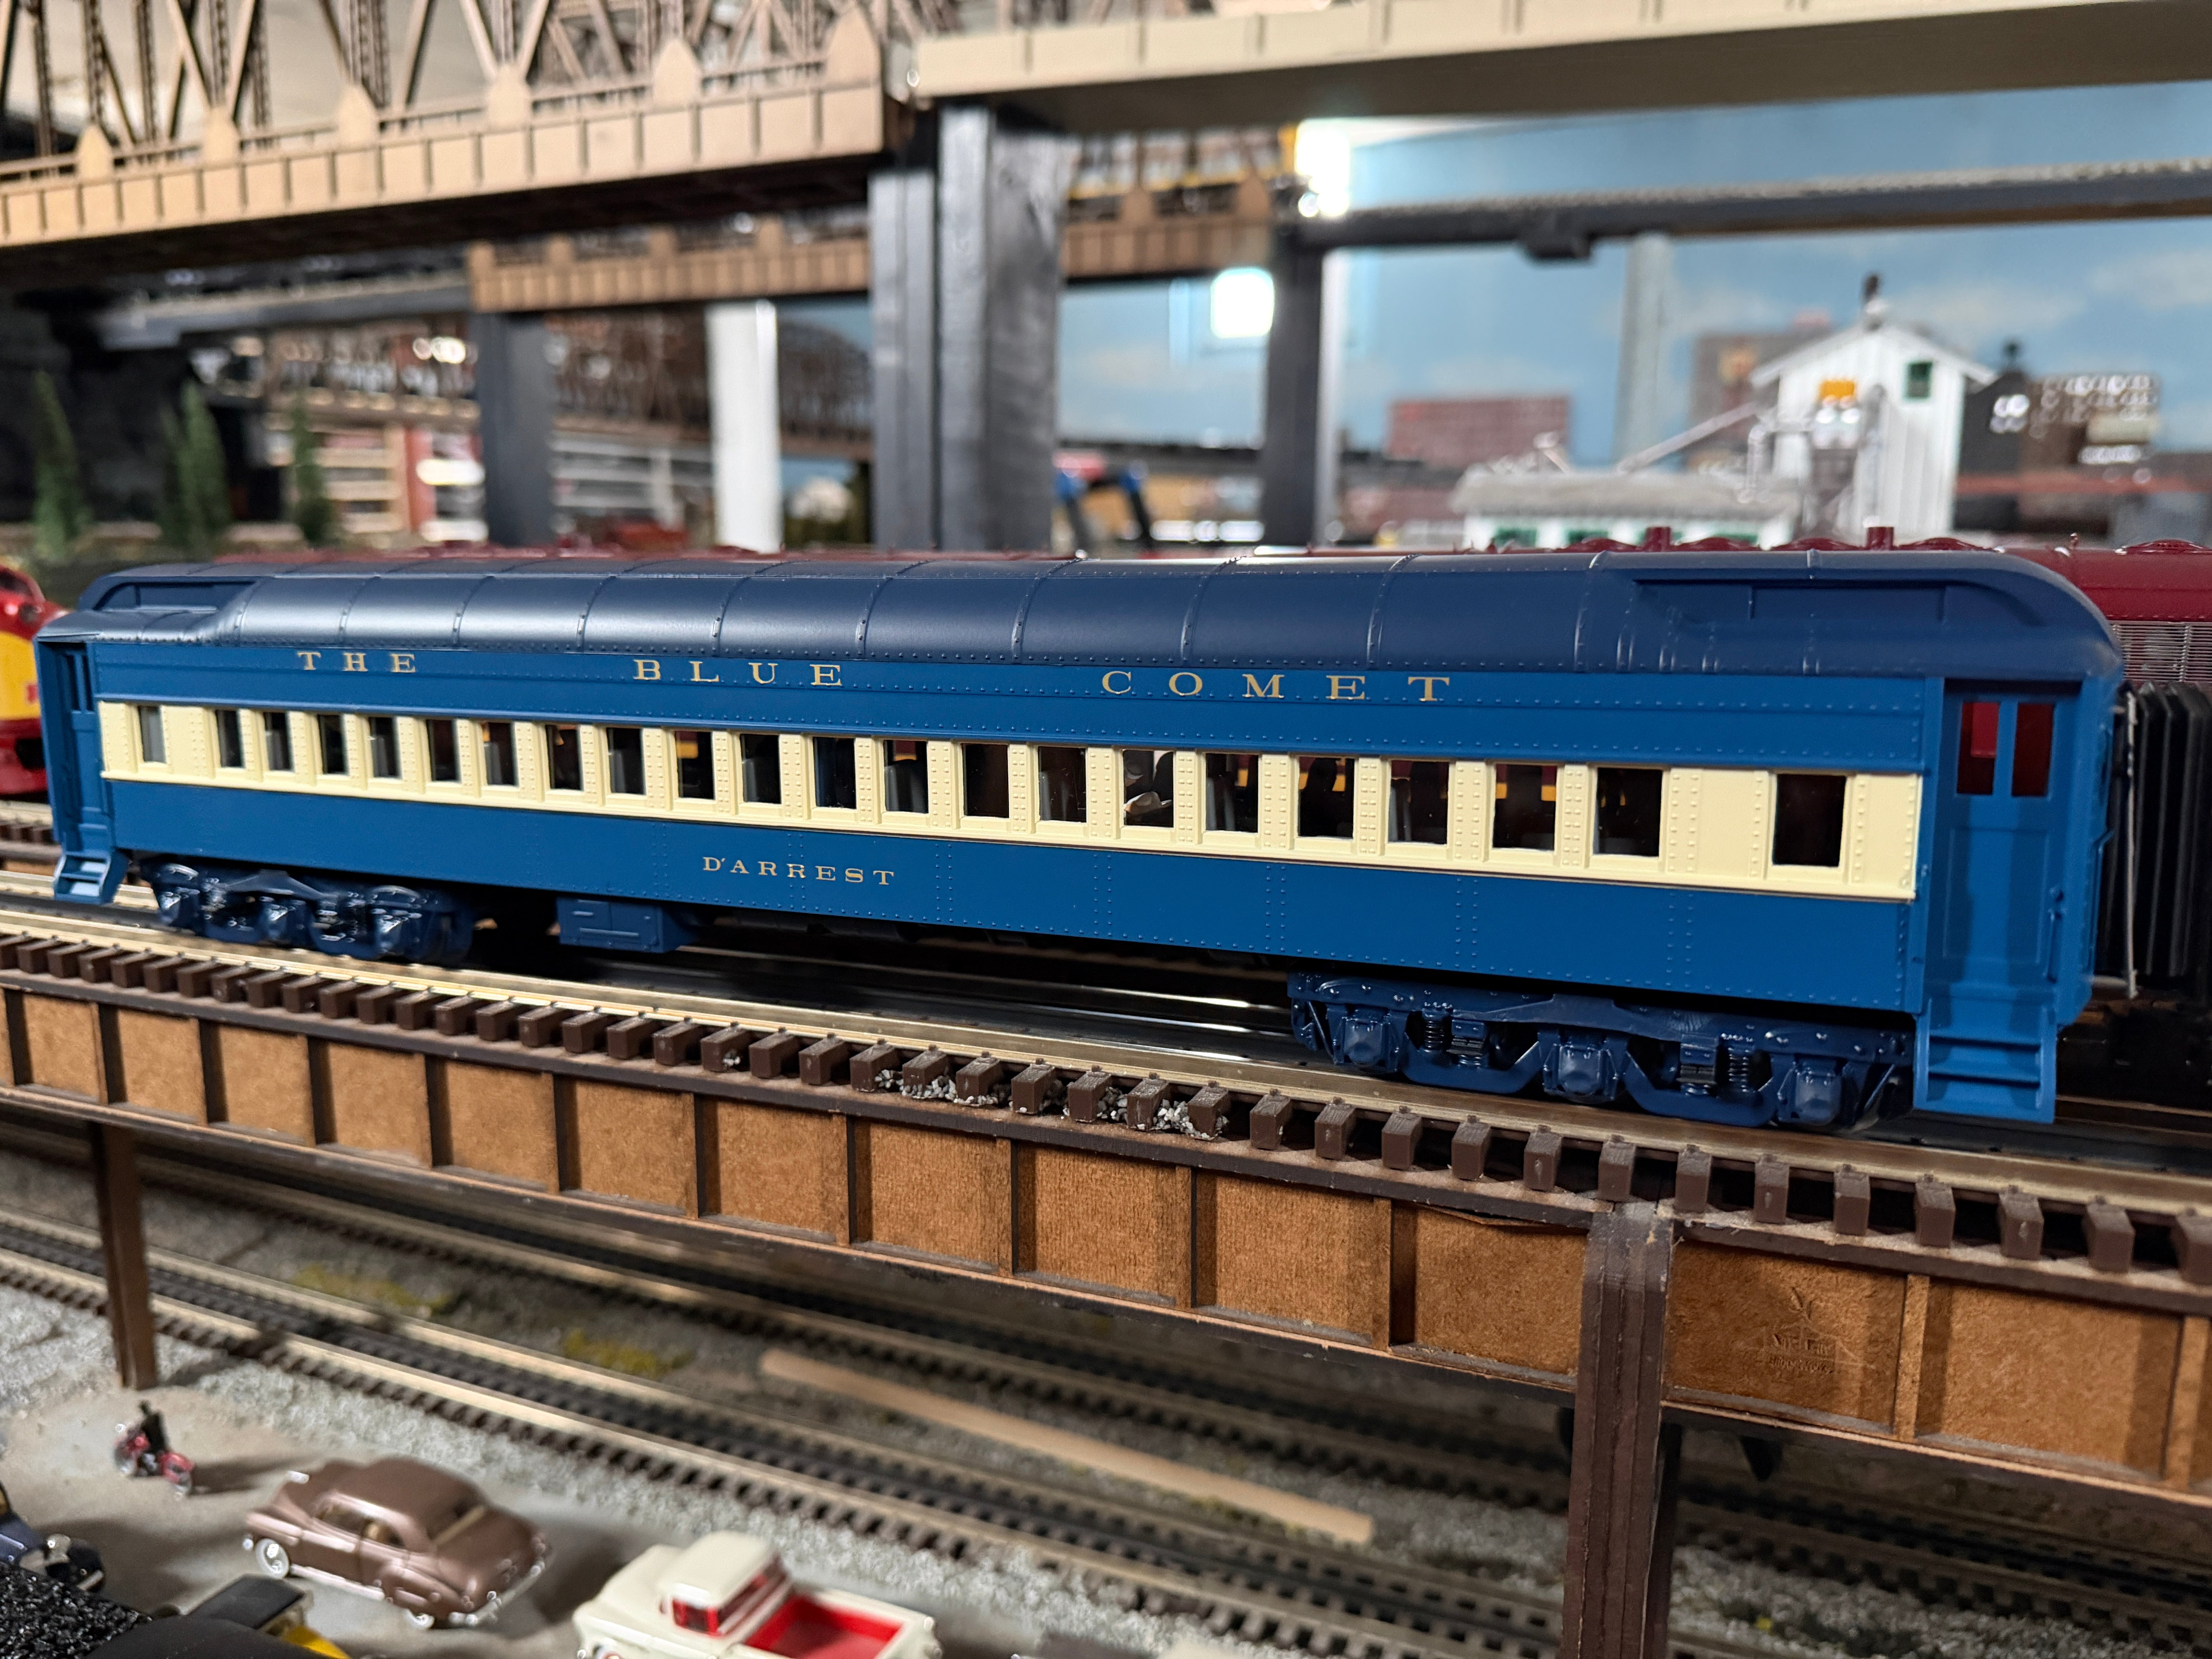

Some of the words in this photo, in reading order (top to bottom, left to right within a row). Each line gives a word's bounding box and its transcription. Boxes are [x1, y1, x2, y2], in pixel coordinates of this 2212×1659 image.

[298, 652, 416, 673] THE
[634, 659, 842, 686] BLUE
[1102, 671, 1450, 701] COMET
[702, 857, 894, 885] D'ARREST
